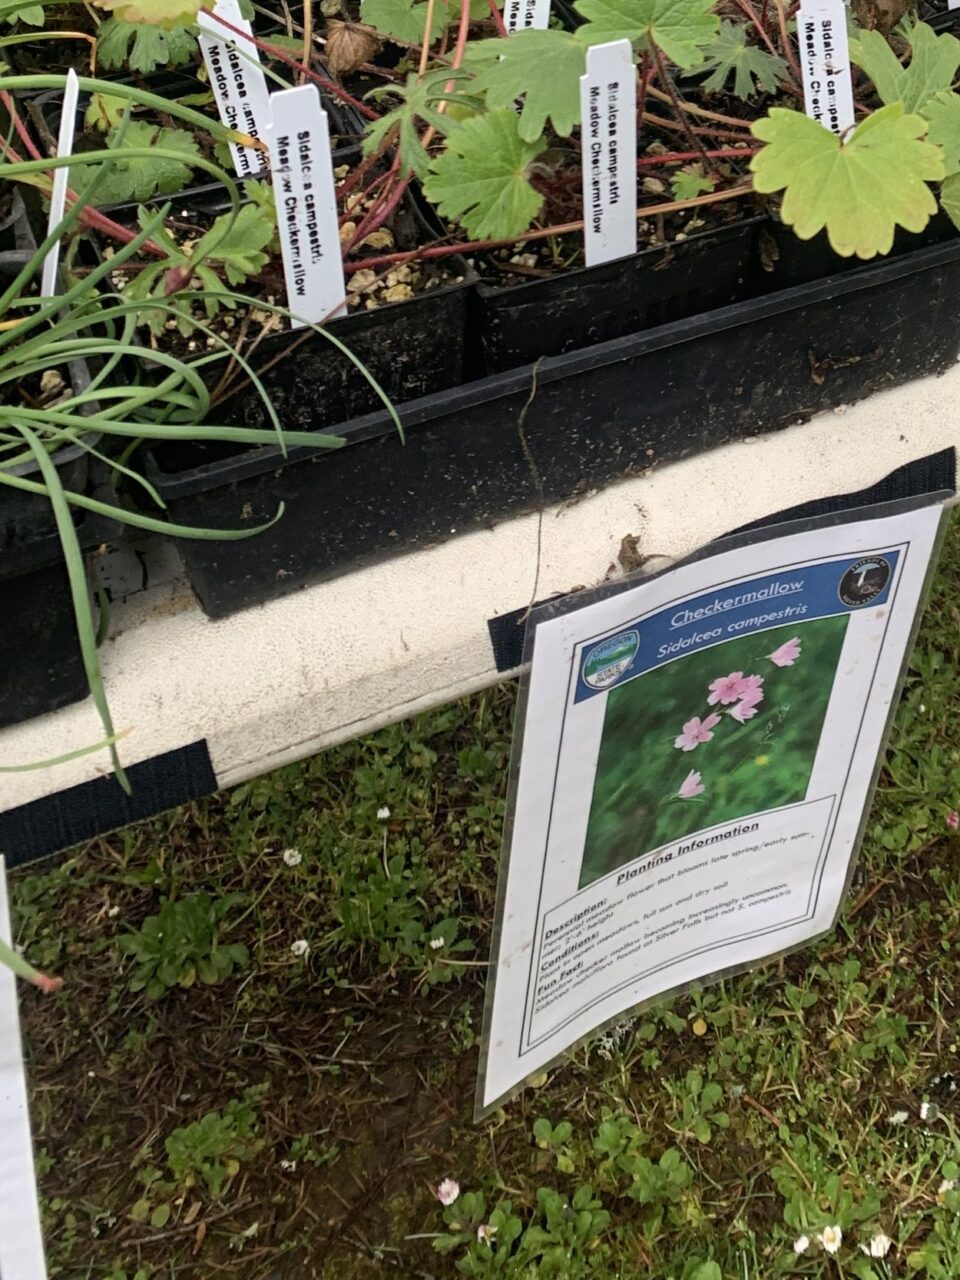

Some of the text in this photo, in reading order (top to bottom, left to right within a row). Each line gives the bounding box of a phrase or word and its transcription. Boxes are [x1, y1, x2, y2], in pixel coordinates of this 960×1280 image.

[297, 130, 313, 190] Sidalca
[589, 86, 603, 233] Meadow Checkermallow
[606, 82, 620, 205] Sidalcea campestris
[671, 578, 805, 627] Checkermallow
[657, 603, 808, 659] Sidalcea campestris
[617, 822, 760, 887] Planting Information
[627, 883, 655, 900] flower
[657, 874, 675, 885] that
[677, 861, 708, 877] blooms
[545, 899, 607, 940] Description:
[541, 930, 600, 972] Conditions:
[537, 979, 557, 995] Fun
